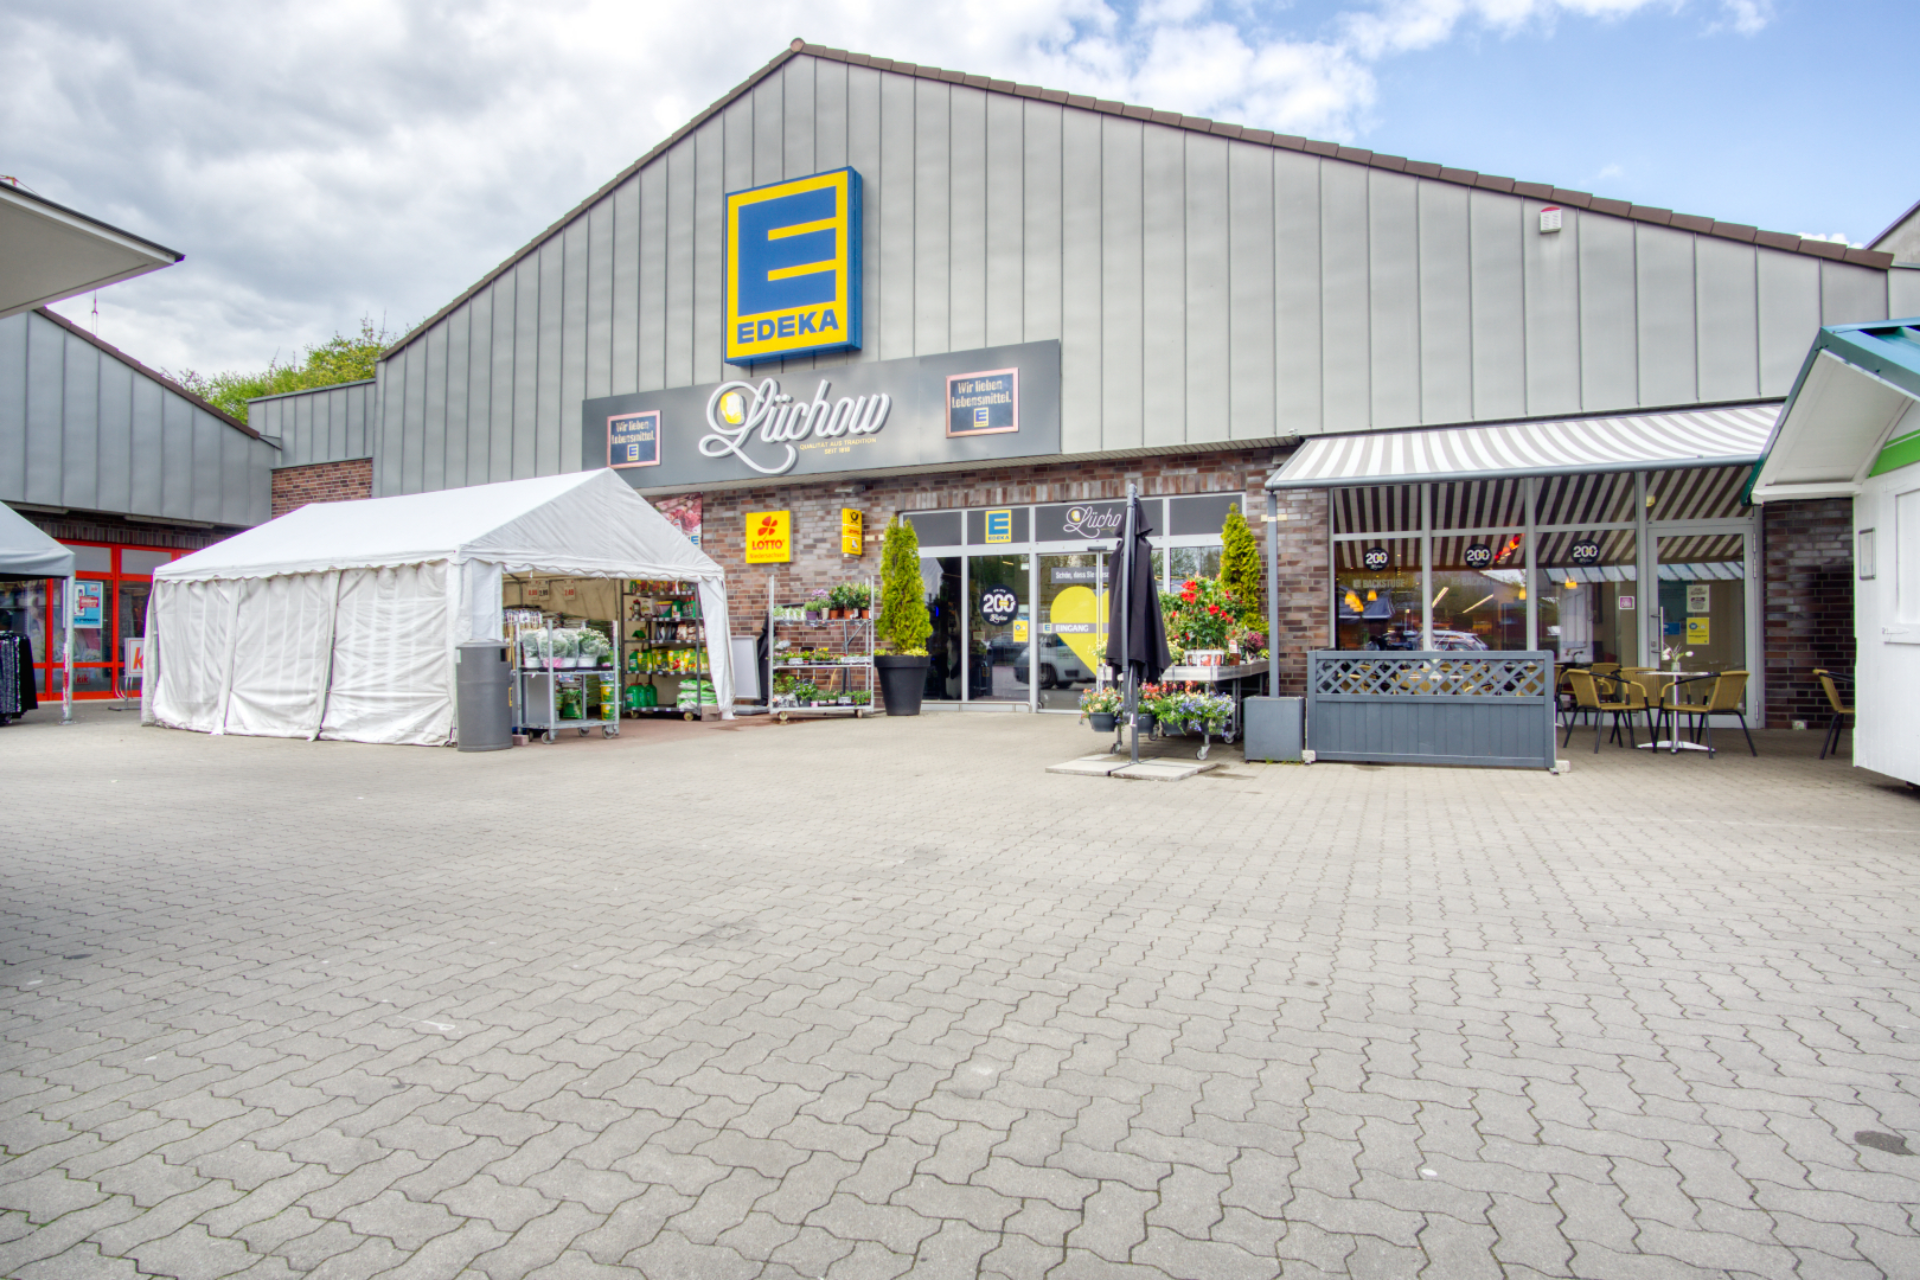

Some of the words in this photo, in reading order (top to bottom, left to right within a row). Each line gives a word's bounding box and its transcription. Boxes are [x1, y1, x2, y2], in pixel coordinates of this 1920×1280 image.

[737, 185, 837, 317] E
[737, 308, 839, 345] EDEKA
[958, 381, 974, 394] Wir
[975, 379, 1003, 393] lieben
[951, 391, 1012, 408] Lebensmittel.
[616, 421, 628, 433] Wir
[628, 420, 649, 431] lieben
[698, 377, 891, 474] Lüchow
[611, 430, 655, 445] Lebensmittel.
[844, 437, 877, 445] TRADITION
[1063, 506, 1122, 538] Lücho
[752, 539, 783, 551] LOTTO
[1574, 545, 1598, 558] 200
[1365, 551, 1388, 564] 200
[1467, 549, 1490, 561] 200
[983, 594, 1016, 613] 200
[1055, 624, 1089, 632] EINGANG
